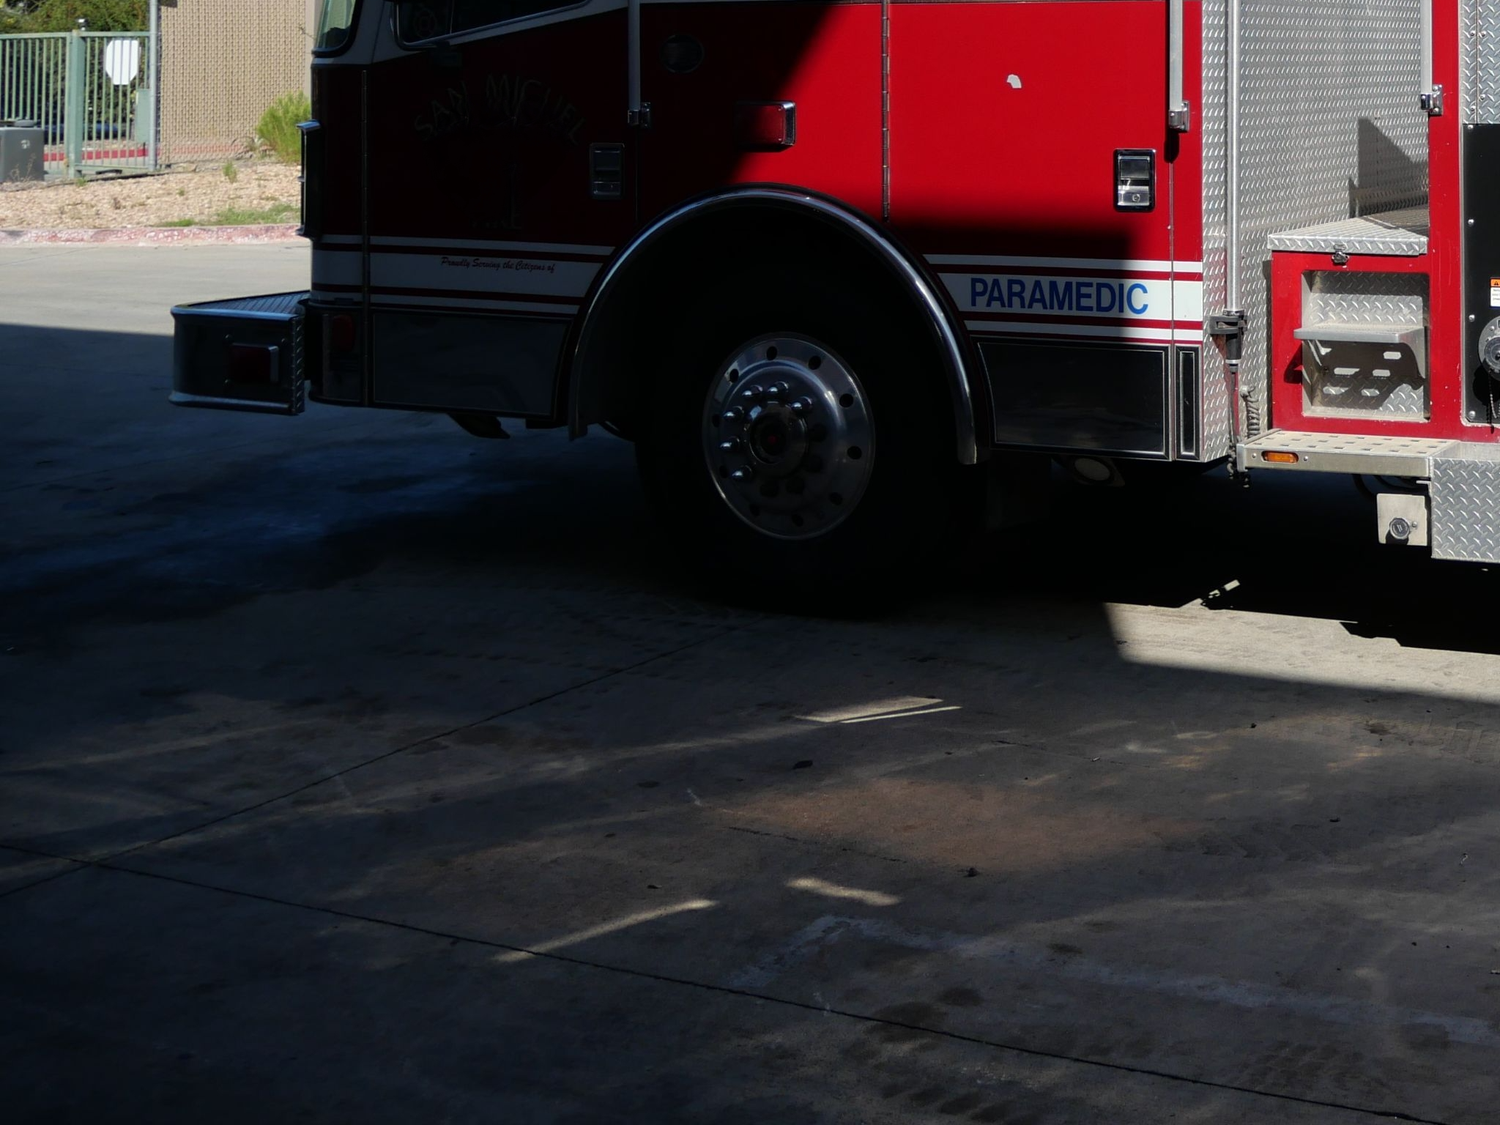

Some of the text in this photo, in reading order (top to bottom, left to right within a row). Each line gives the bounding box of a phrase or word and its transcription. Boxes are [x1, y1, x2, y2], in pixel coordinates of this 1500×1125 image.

[440, 256, 555, 273] Proudly Serving the Citizens of
[970, 277, 1149, 315] PARAMEDIC
